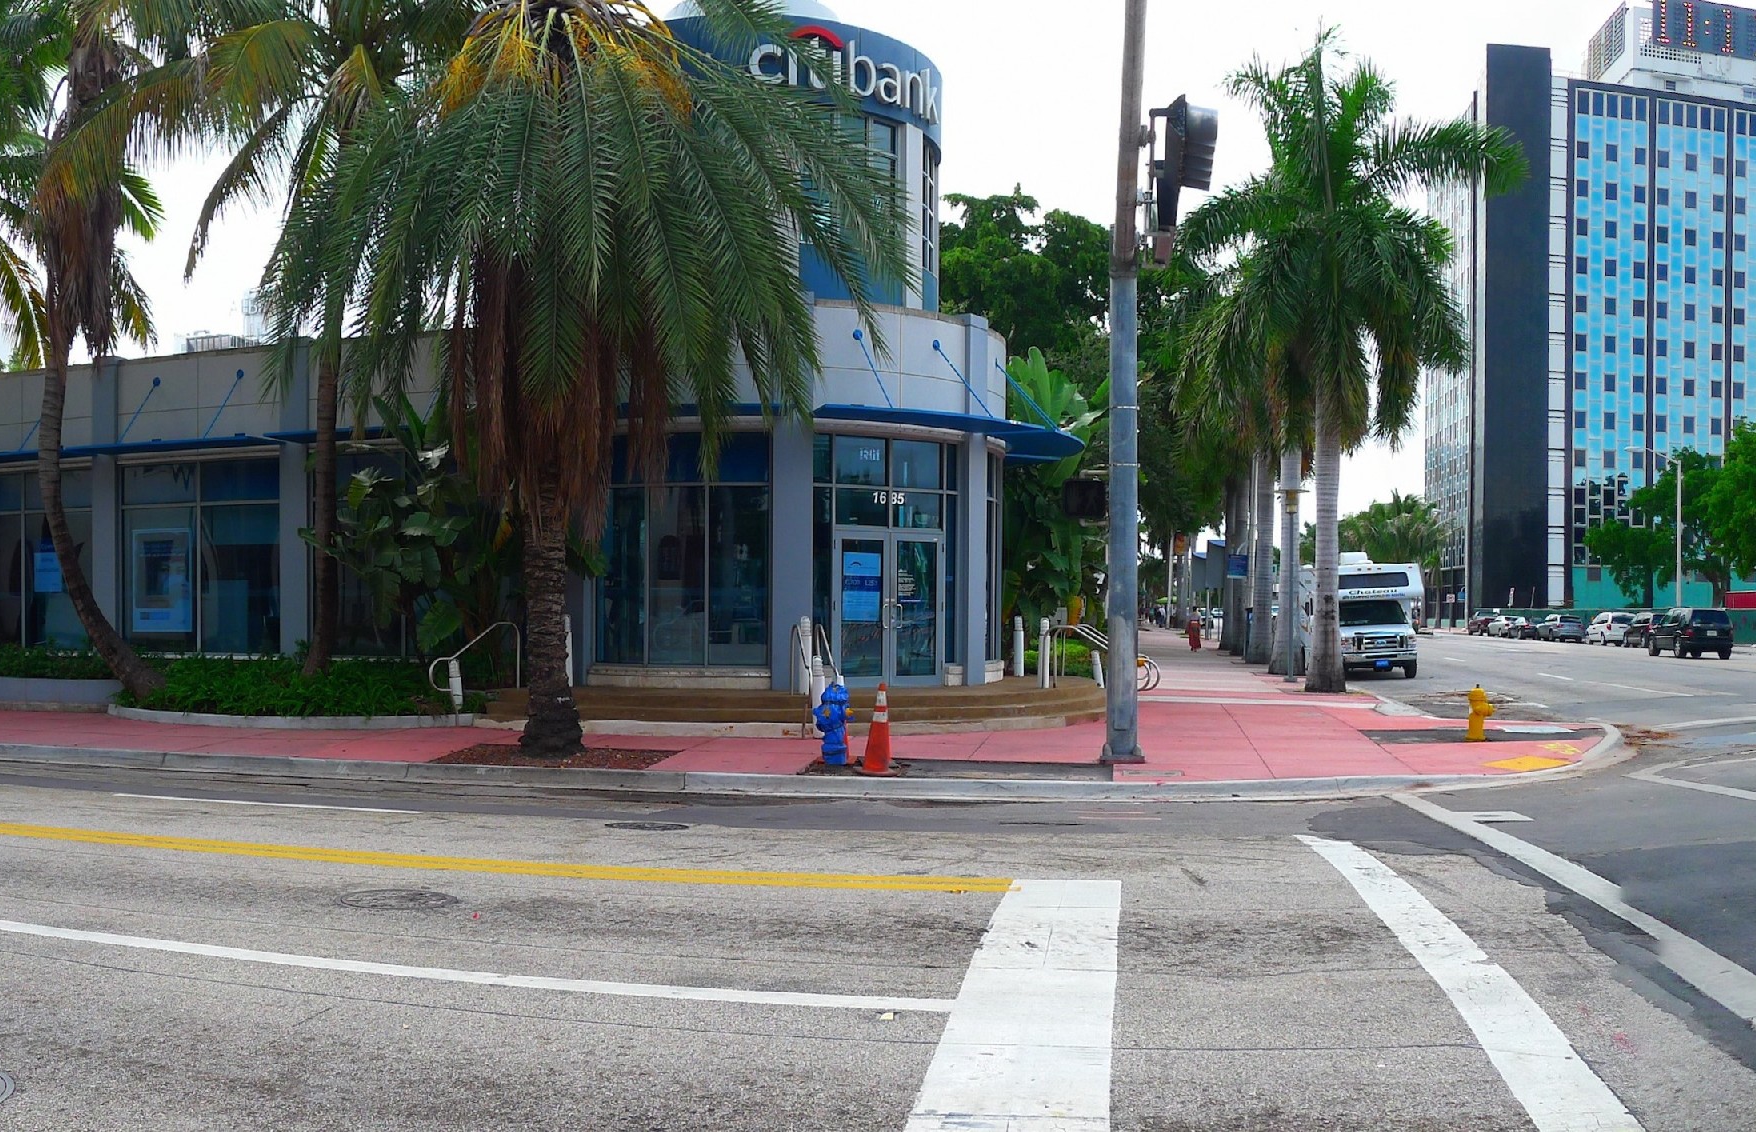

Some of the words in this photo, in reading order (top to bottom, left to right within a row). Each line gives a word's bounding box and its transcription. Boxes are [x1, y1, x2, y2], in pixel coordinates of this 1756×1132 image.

[748, 35, 939, 125] citibank
[872, 491, 906, 505] 1685
[1348, 588, 1398, 596] Chateau
